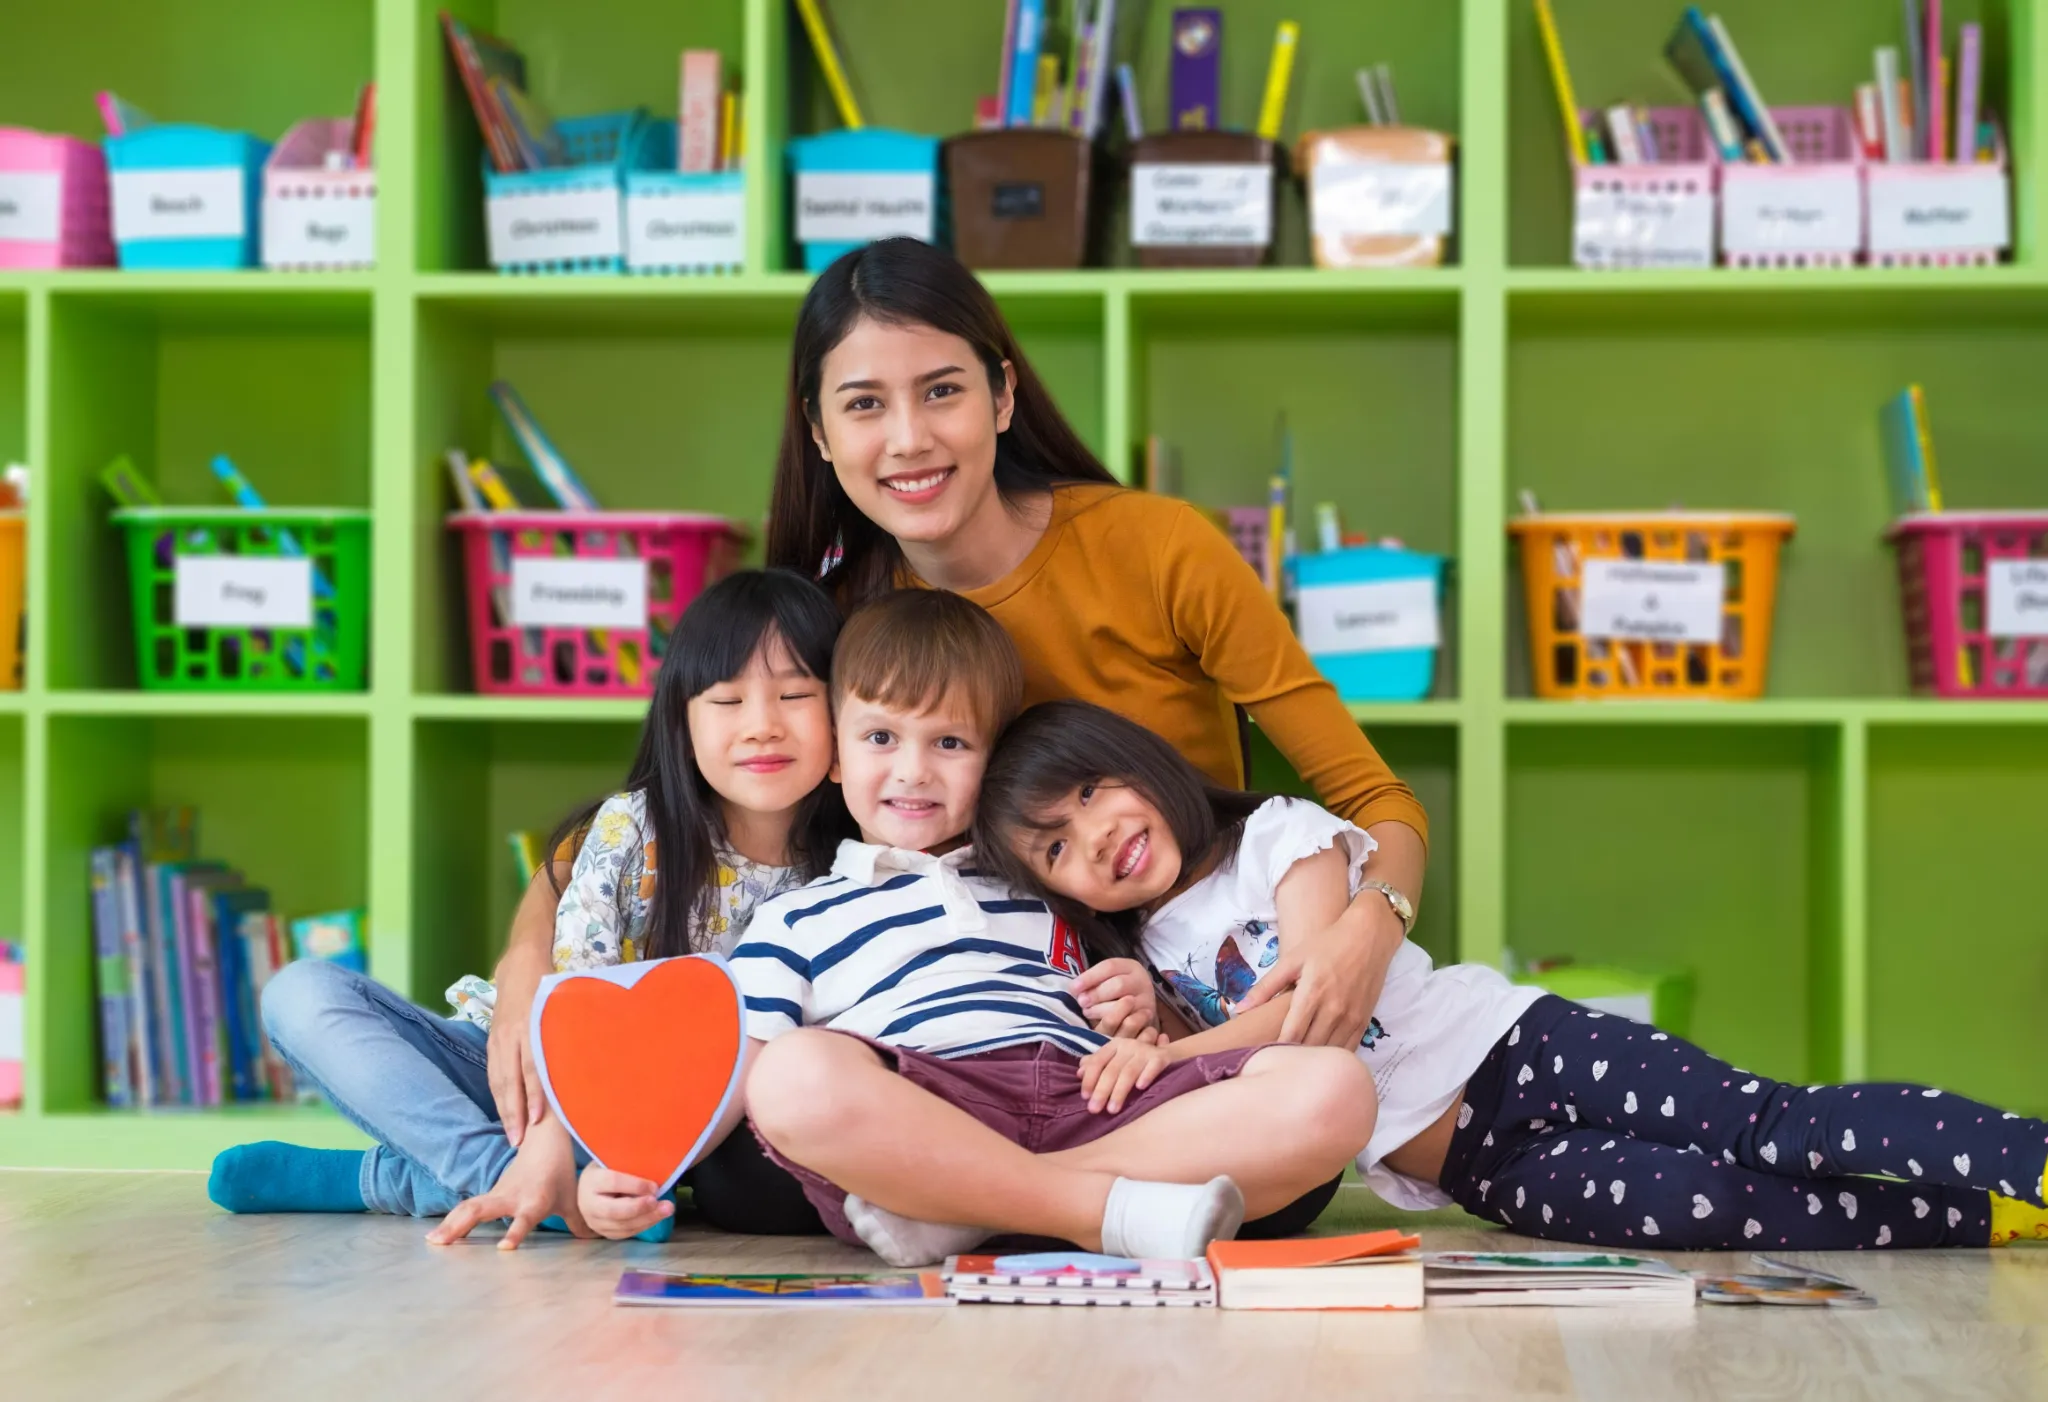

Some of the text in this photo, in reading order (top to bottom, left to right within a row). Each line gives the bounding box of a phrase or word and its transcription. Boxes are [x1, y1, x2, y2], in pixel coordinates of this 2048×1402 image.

[511, 217, 599, 239] Christmas
[647, 219, 735, 239] Christmas
[530, 582, 627, 609] Friendship
[1047, 914, 1088, 979] A
